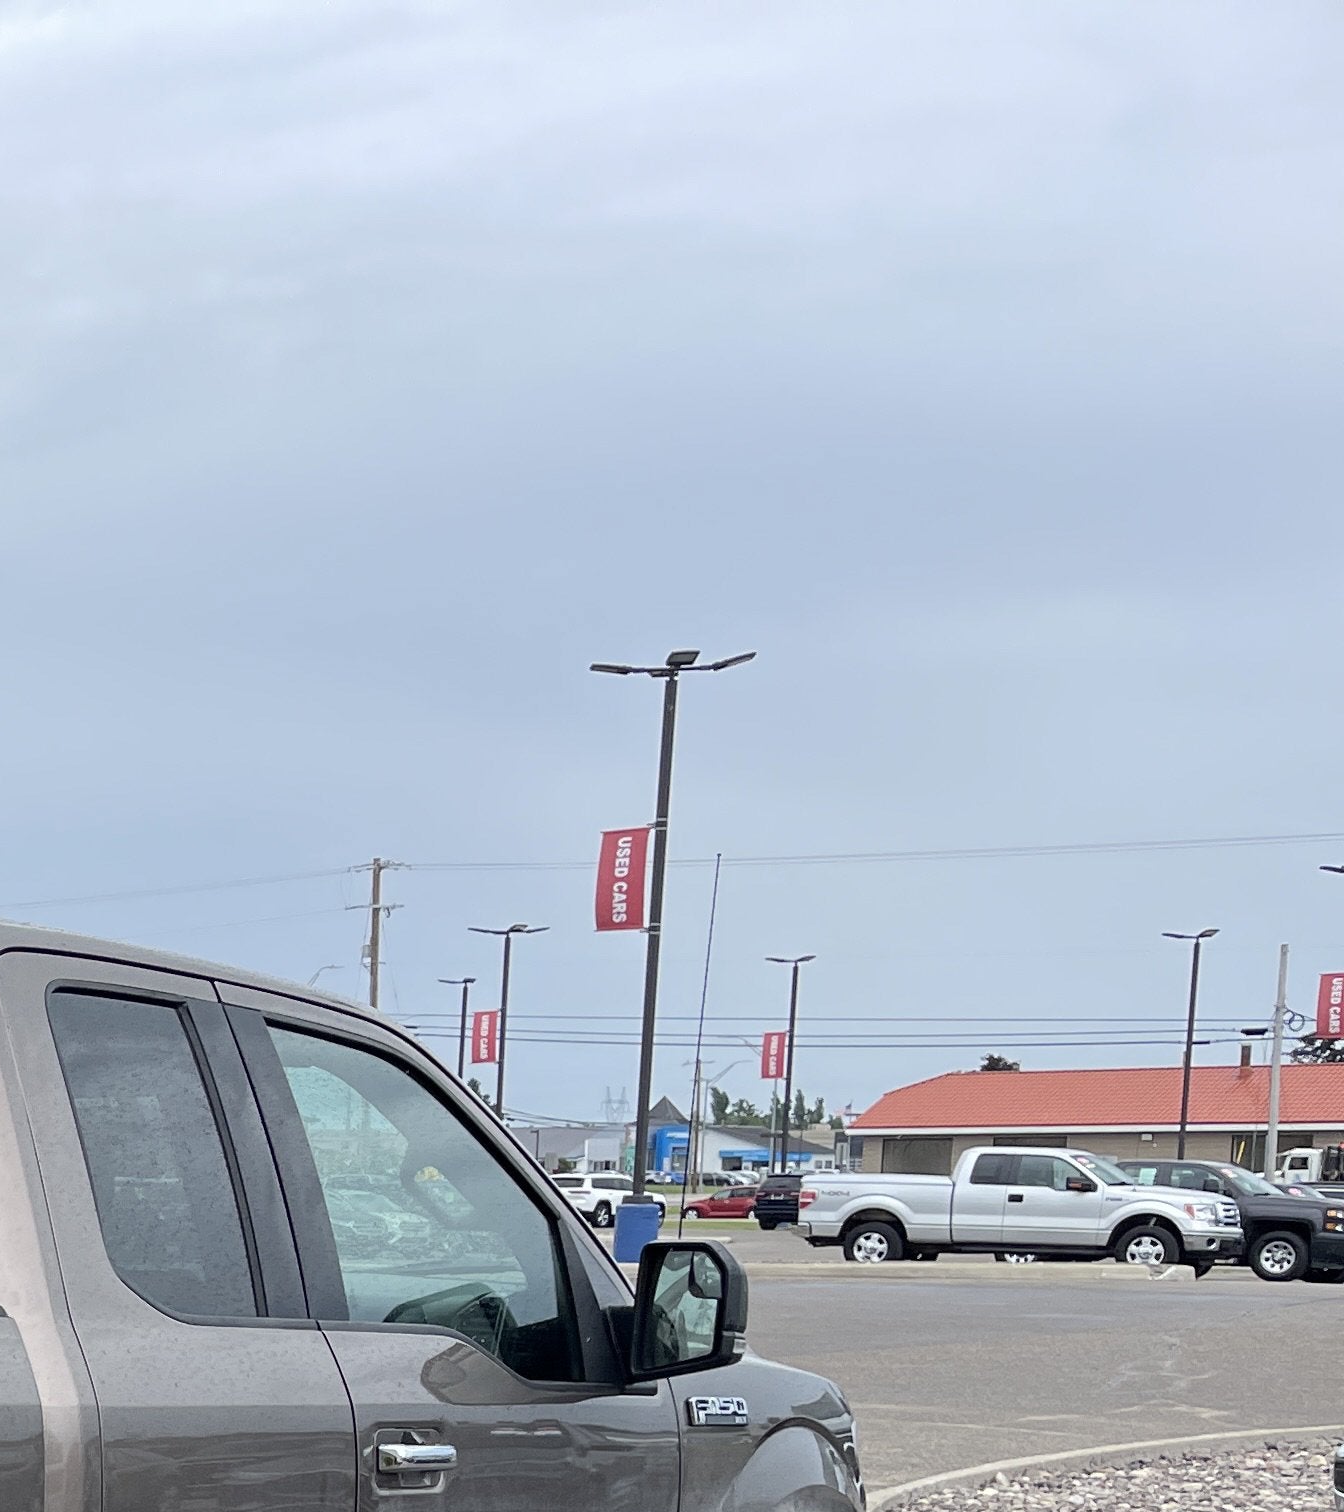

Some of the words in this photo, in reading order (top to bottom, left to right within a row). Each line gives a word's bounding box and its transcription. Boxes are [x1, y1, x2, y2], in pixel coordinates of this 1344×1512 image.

[614, 836, 633, 878] USED
[612, 881, 629, 924] CARS
[1330, 977, 1344, 1005] USED
[1328, 1006, 1341, 1034] CARS
